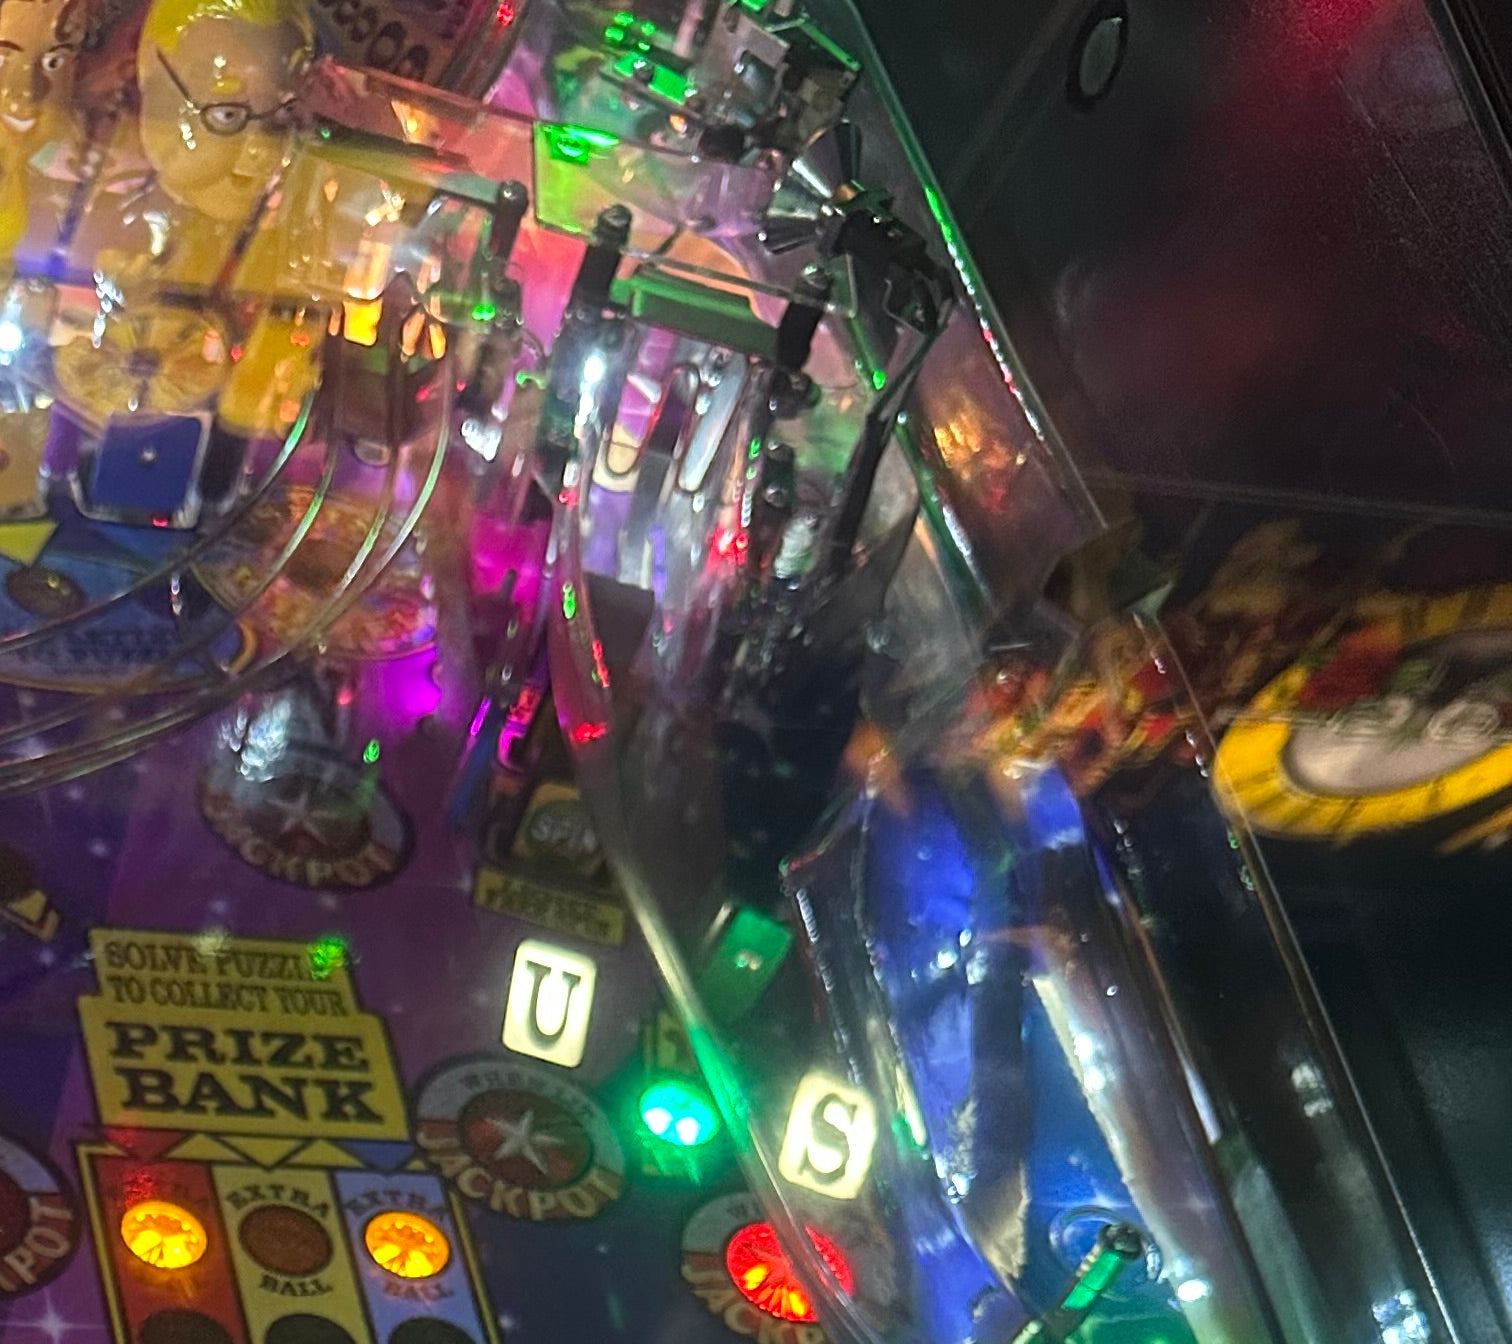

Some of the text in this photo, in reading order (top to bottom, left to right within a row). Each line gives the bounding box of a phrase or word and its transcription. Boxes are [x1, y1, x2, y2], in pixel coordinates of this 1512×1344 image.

[103, 941, 207, 974] SOLVE
[105, 976, 349, 1018] TO COLLECT YOUR
[525, 961, 582, 1047] U
[104, 1020, 372, 1074] PRIZE
[112, 1066, 385, 1126] BANK
[797, 1092, 860, 1188] S
[415, 1126, 621, 1222] JACKPOT
[225, 1182, 334, 1222] EXTRA
[257, 1272, 334, 1298] BALL
